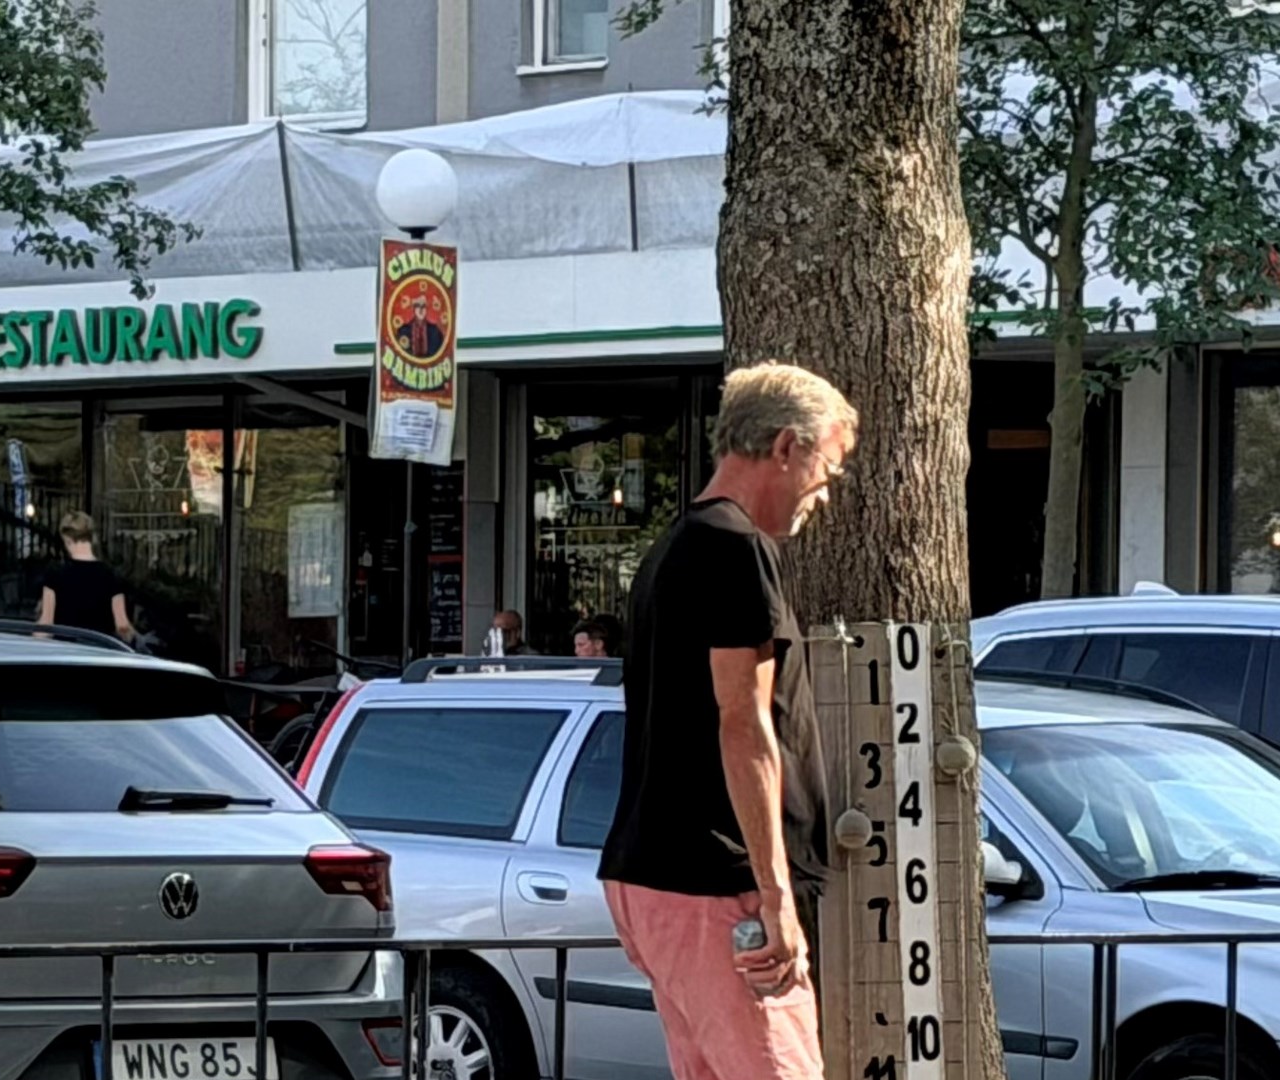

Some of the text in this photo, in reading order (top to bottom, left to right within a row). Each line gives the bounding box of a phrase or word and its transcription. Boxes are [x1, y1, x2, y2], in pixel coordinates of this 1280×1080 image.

[387, 249, 454, 288] CIRKUS
[896, 625, 919, 670] 0
[868, 659, 880, 705] 1
[896, 703, 920, 744] 2
[859, 742, 882, 789] 3
[898, 781, 922, 827] 4
[866, 821, 888, 866] 5
[905, 858, 928, 905] 6
[867, 897, 890, 942] 7
[908, 940, 931, 986] 8
[907, 1015, 941, 1062] 10
[122, 1043, 190, 1080] WNG
